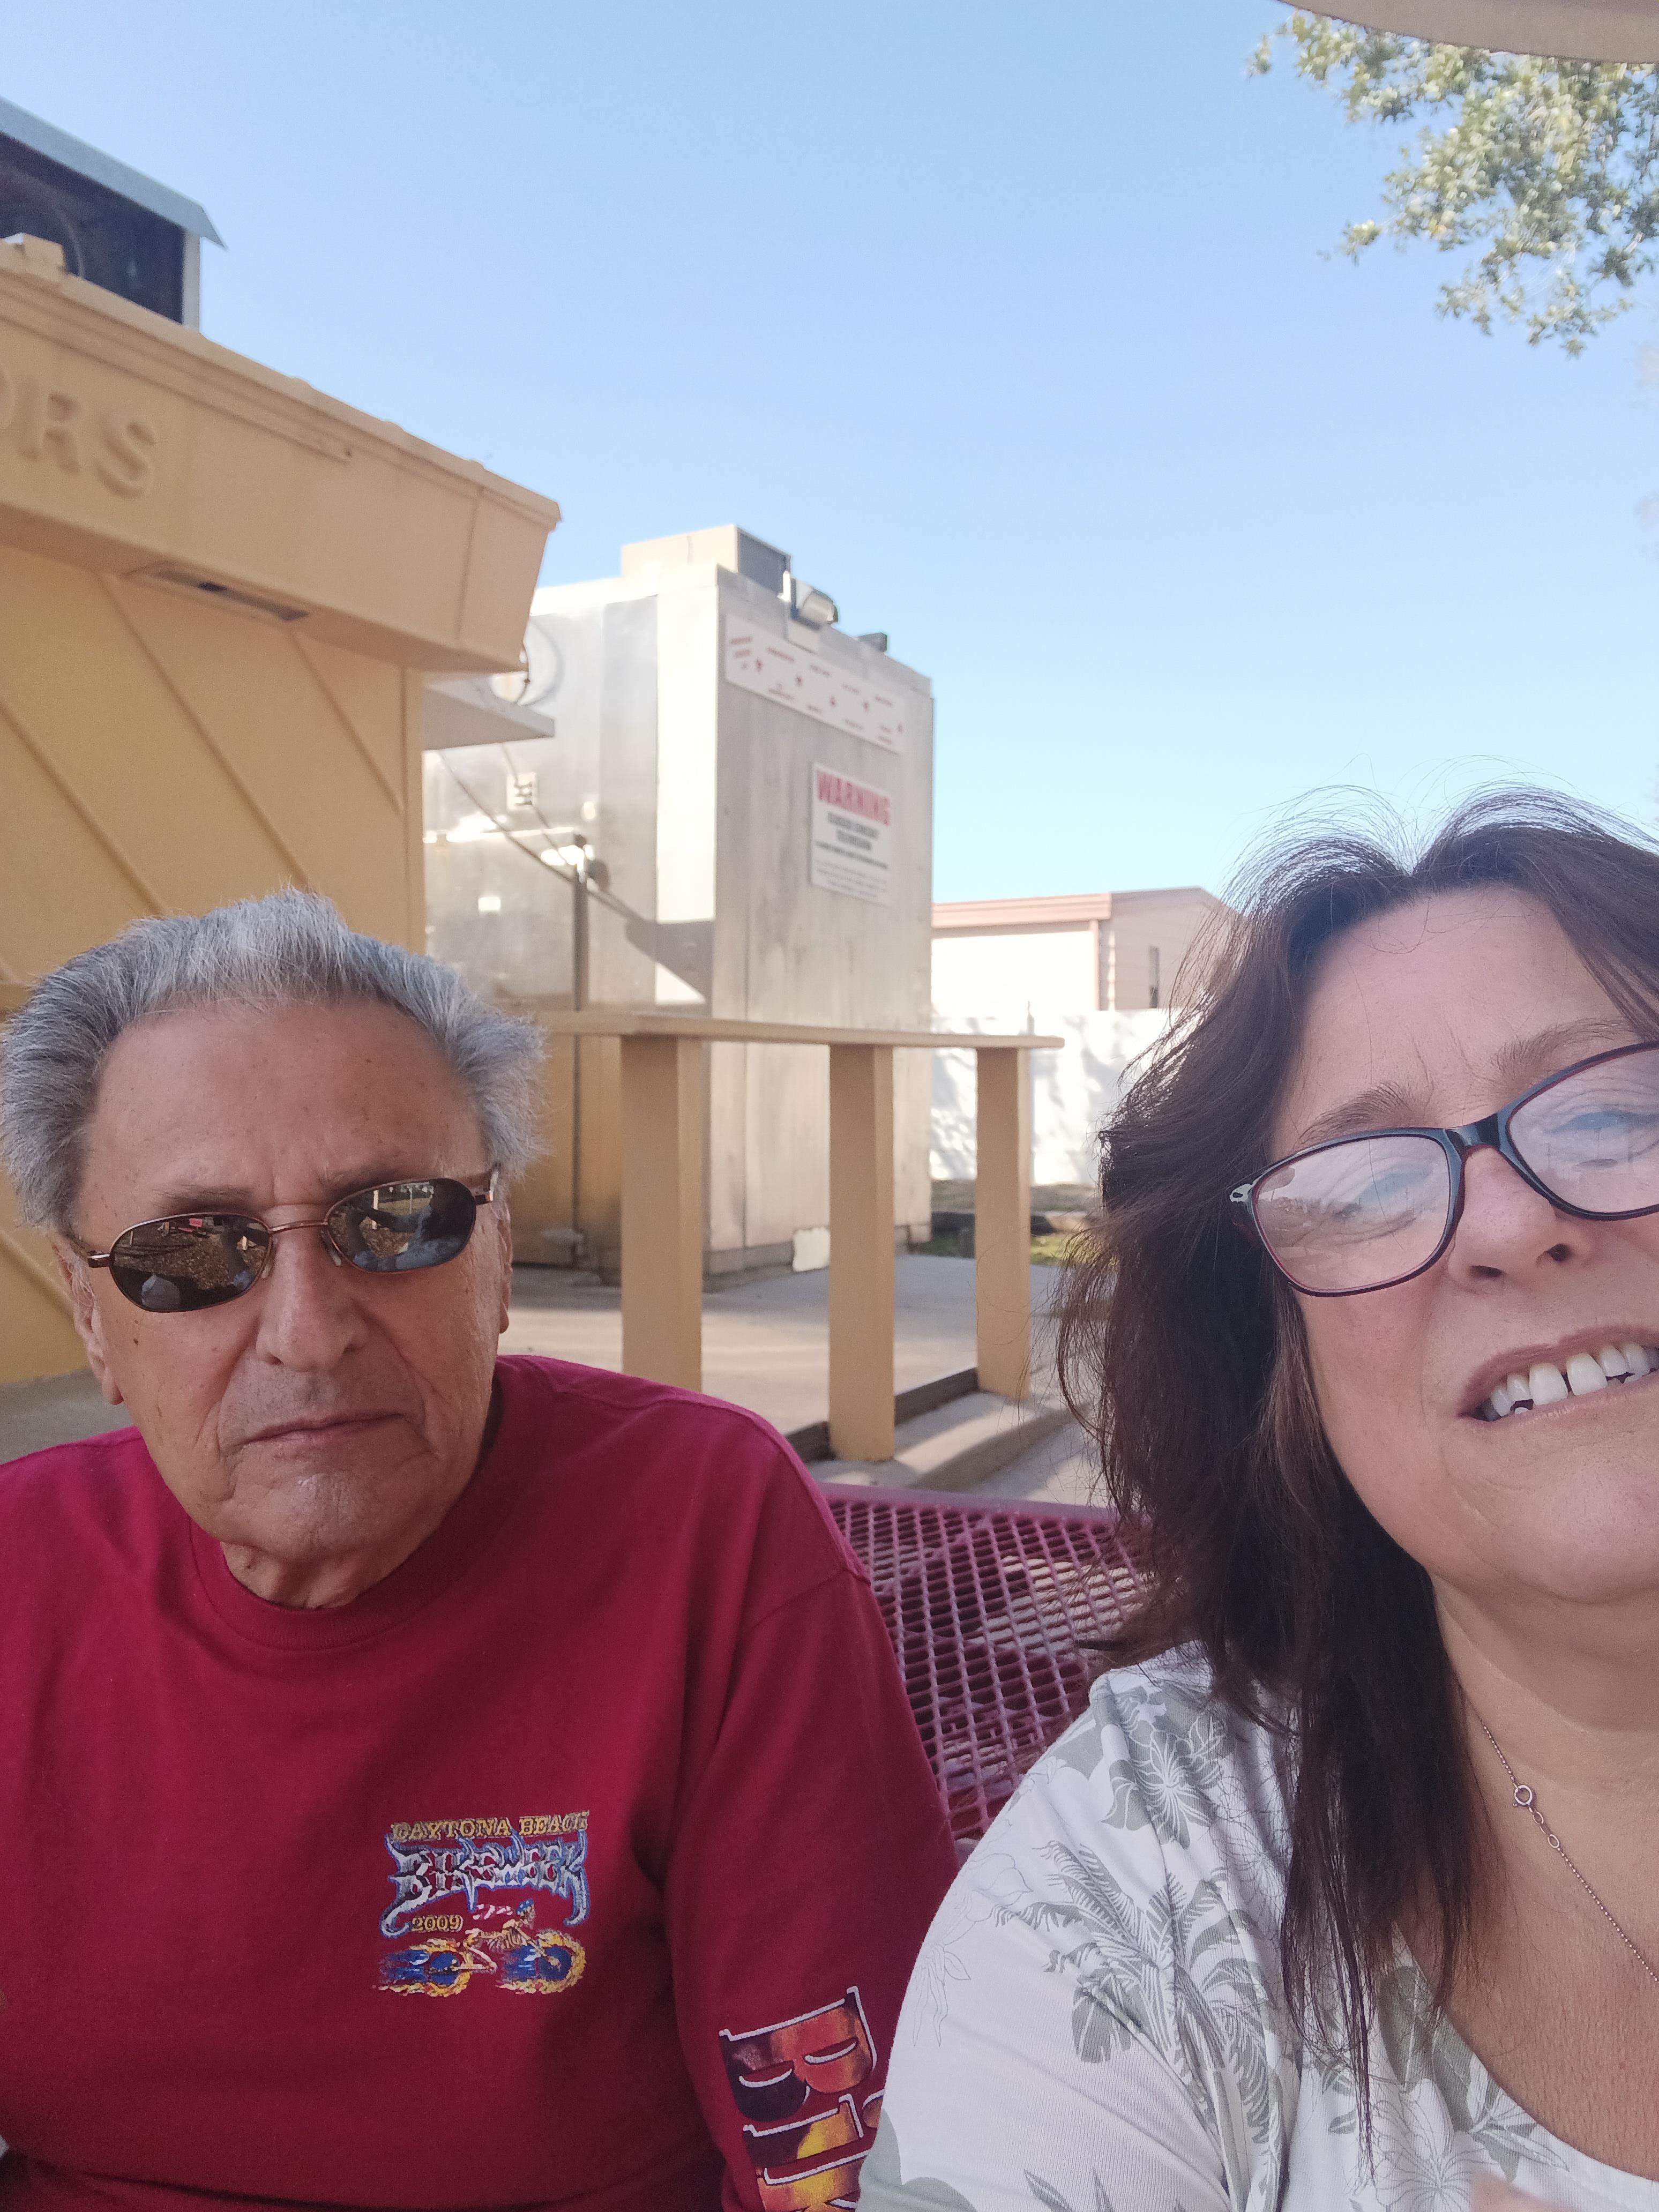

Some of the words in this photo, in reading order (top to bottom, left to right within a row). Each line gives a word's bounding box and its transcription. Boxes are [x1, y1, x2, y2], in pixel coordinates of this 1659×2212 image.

[391, 1818, 513, 1843] DAYTONA
[519, 1810, 589, 1837] BEACH
[411, 1914, 464, 1933] 2009
